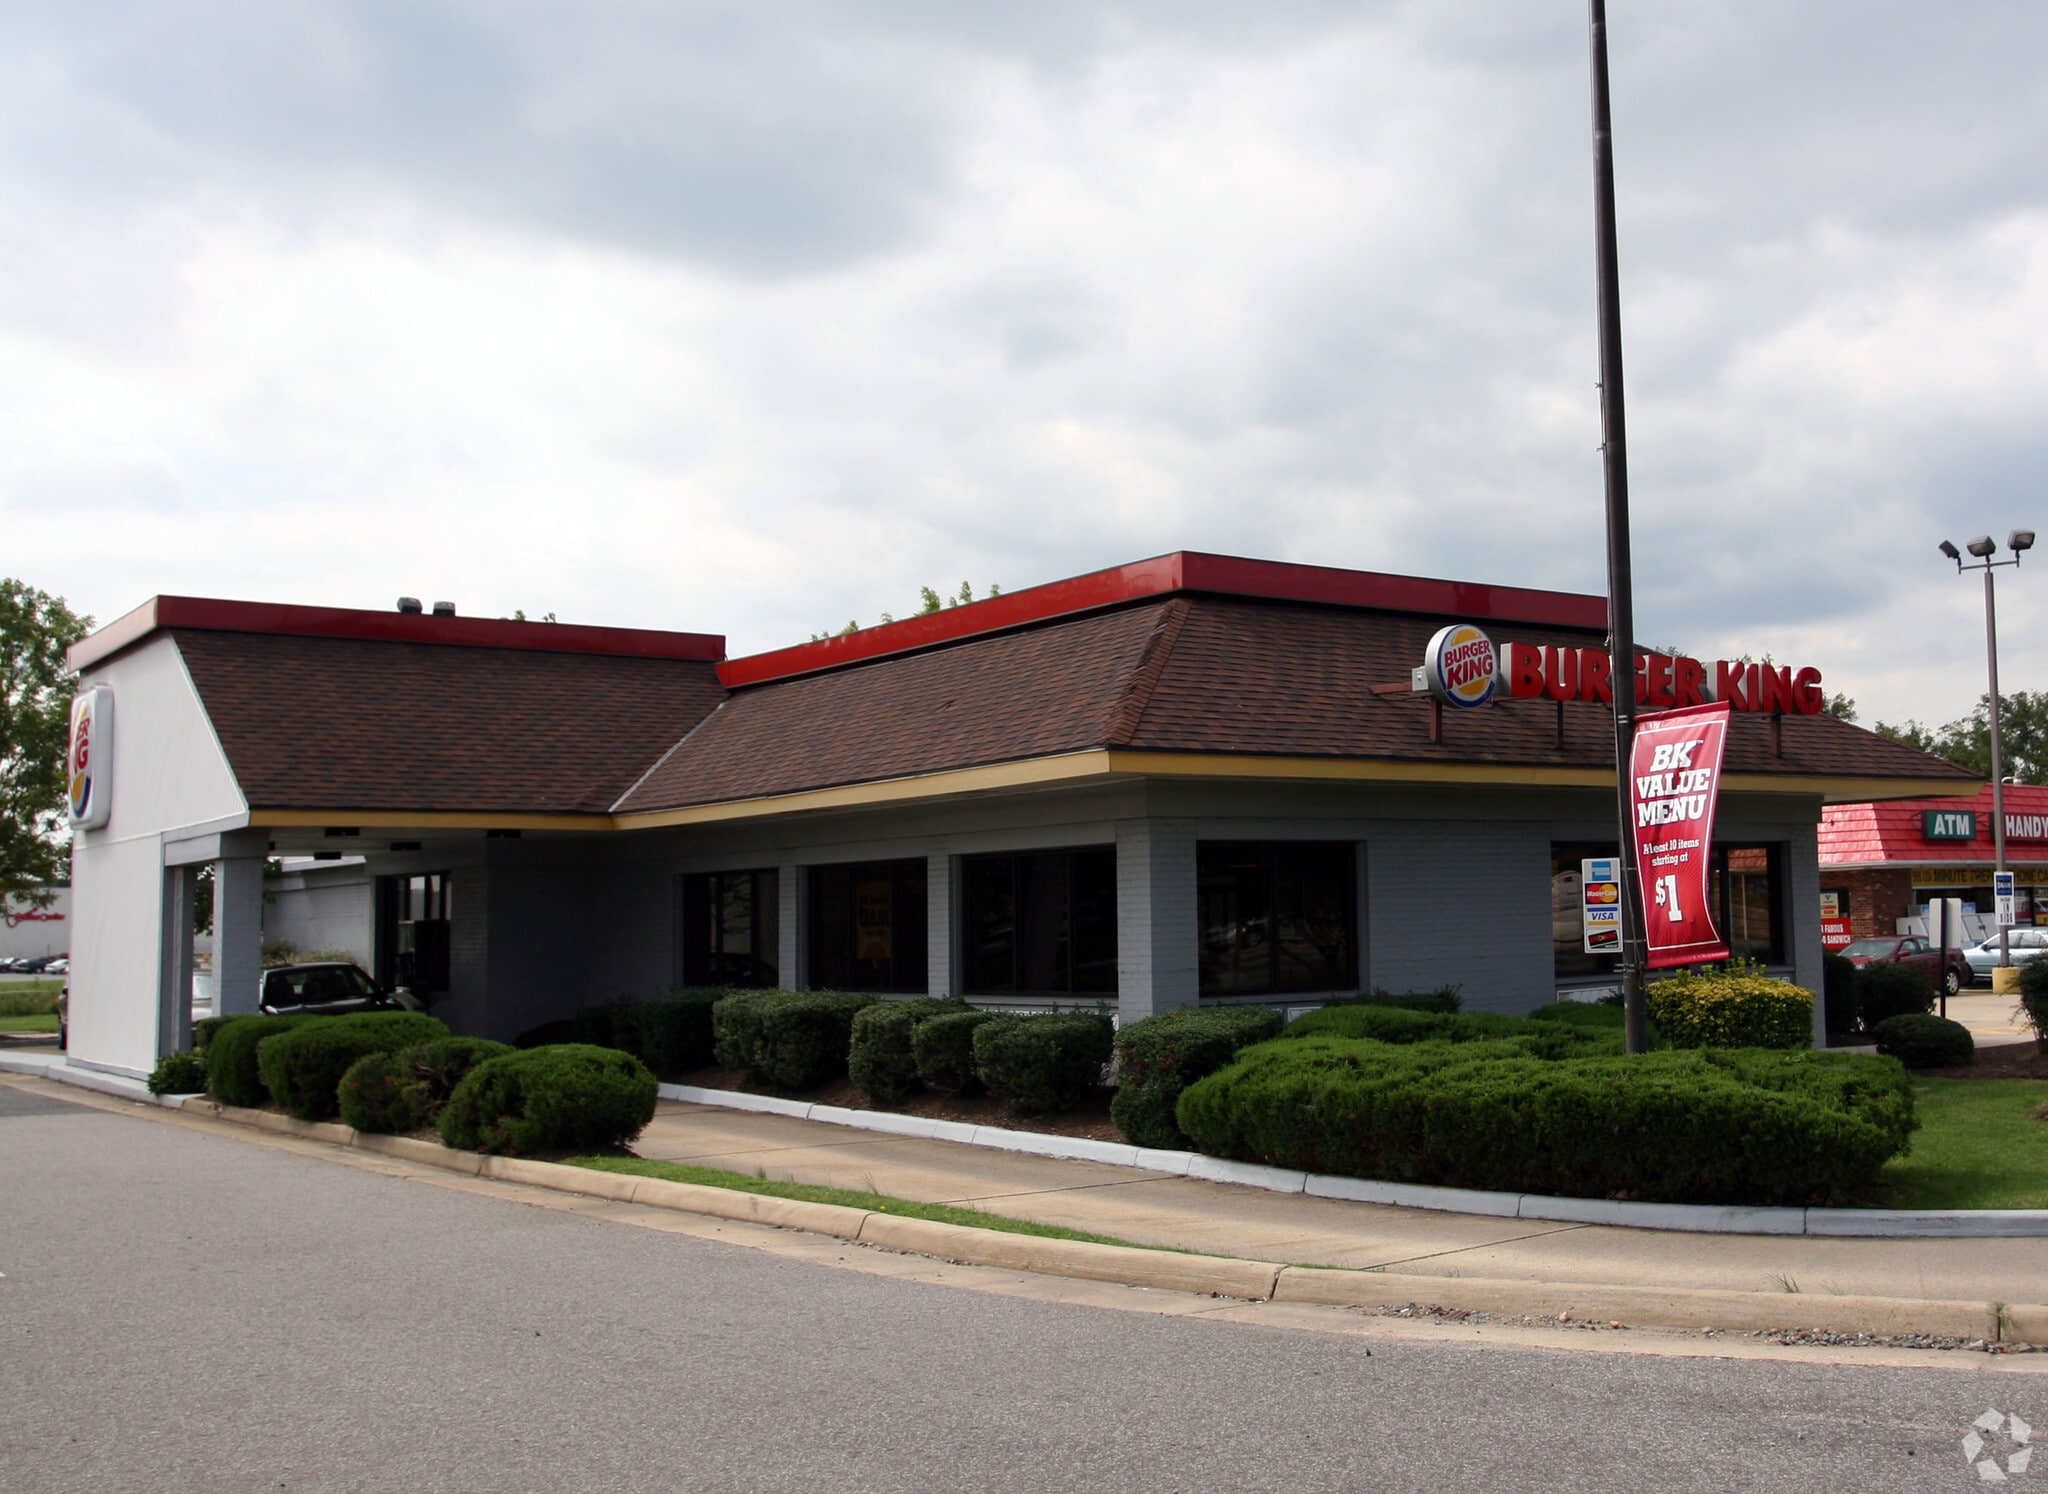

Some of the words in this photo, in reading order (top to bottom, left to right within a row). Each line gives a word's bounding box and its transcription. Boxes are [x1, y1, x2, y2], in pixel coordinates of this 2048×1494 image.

[1444, 639, 1491, 668] BURGER
[1446, 654, 1493, 690] KING
[1709, 660, 1822, 715] KING
[1636, 768, 1711, 799] VALUE
[1637, 794, 1707, 827] MENU
[1934, 814, 1970, 836] ATM
[2005, 814, 2048, 838] HANDY
[1678, 838, 1700, 849] items
[1651, 853, 1679, 867] starting
[1680, 851, 1688, 862] at
[1655, 874, 1683, 921] $1
[1591, 912, 1614, 921] VISA
